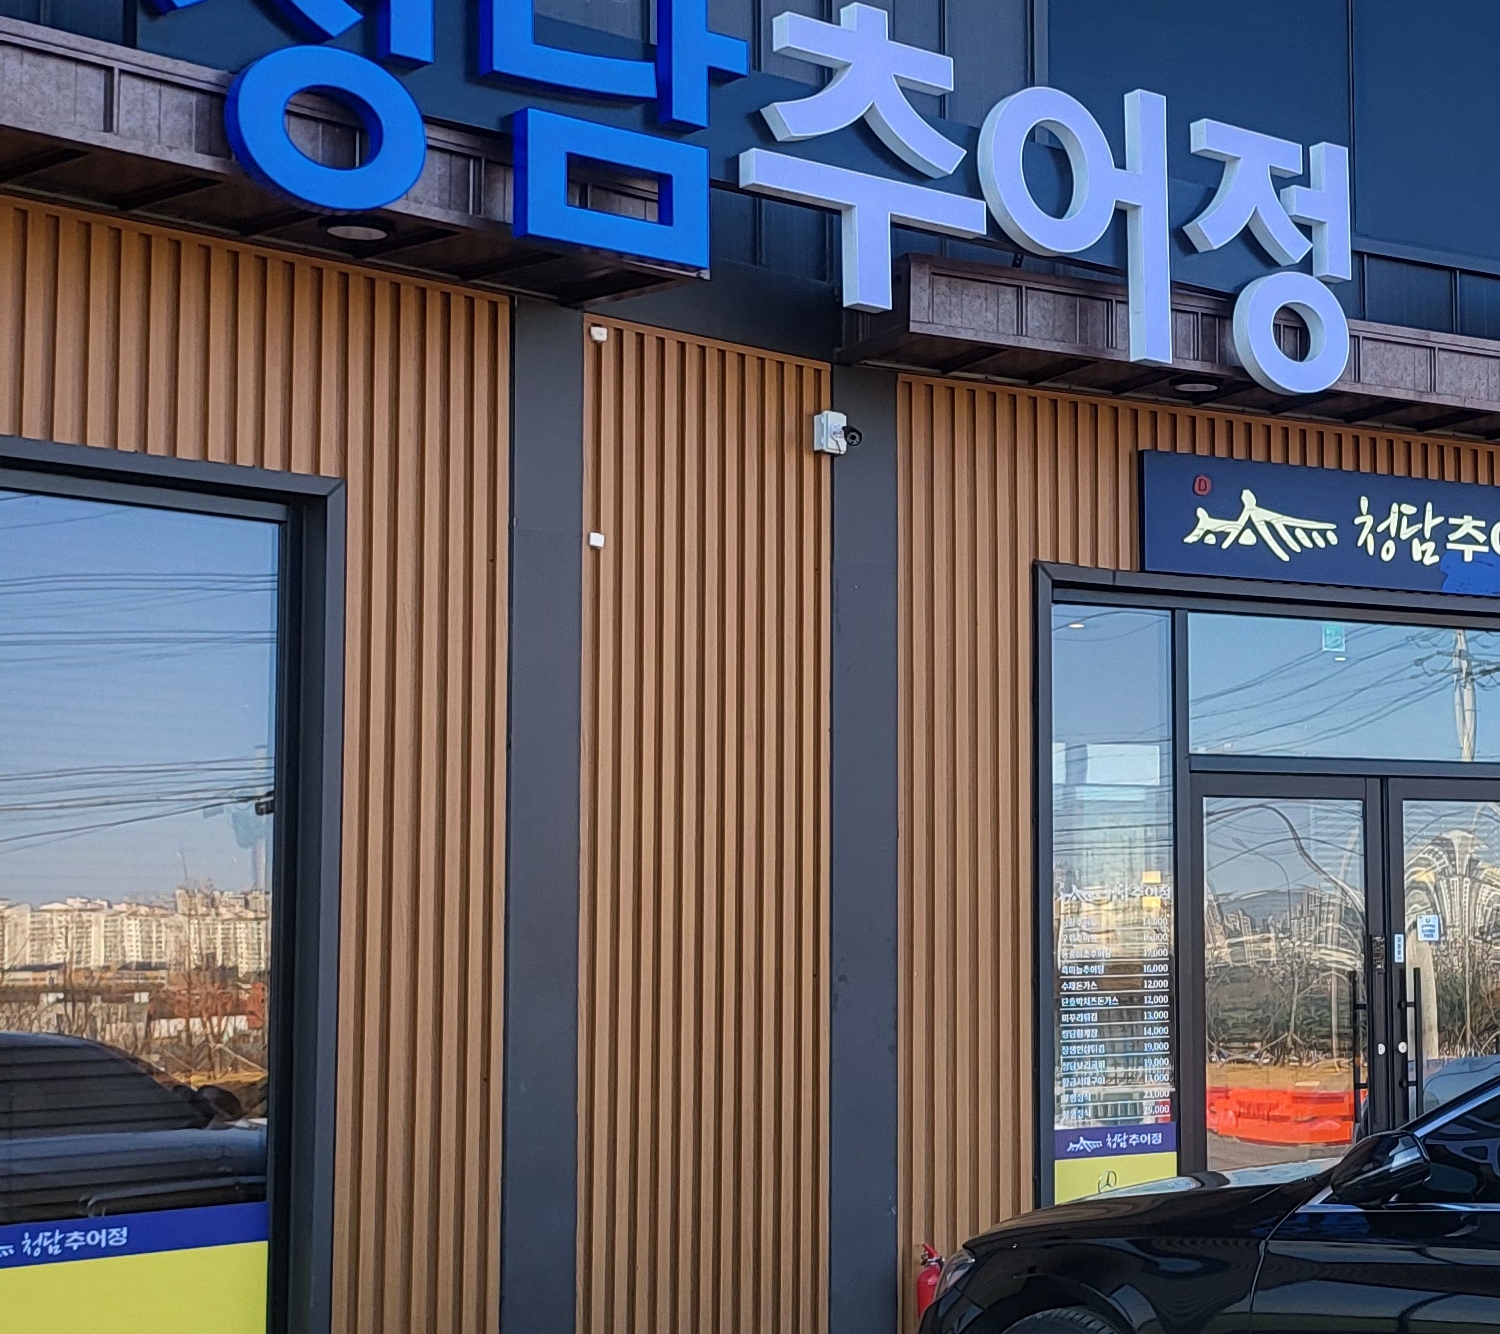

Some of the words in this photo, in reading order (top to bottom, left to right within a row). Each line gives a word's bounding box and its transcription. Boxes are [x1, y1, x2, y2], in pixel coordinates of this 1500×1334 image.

[1061, 981, 1098, 990] 수제돈가스
[1143, 979, 1169, 989] 12,000
[1061, 996, 1120, 1007] 단호박치즈돈가스
[1143, 995, 1169, 1005] 12,000
[1143, 1026, 1169, 1036] 14,000
[1105, 1132, 1163, 1149] 청담추어정
[21, 1226, 128, 1257] 청담추어정
